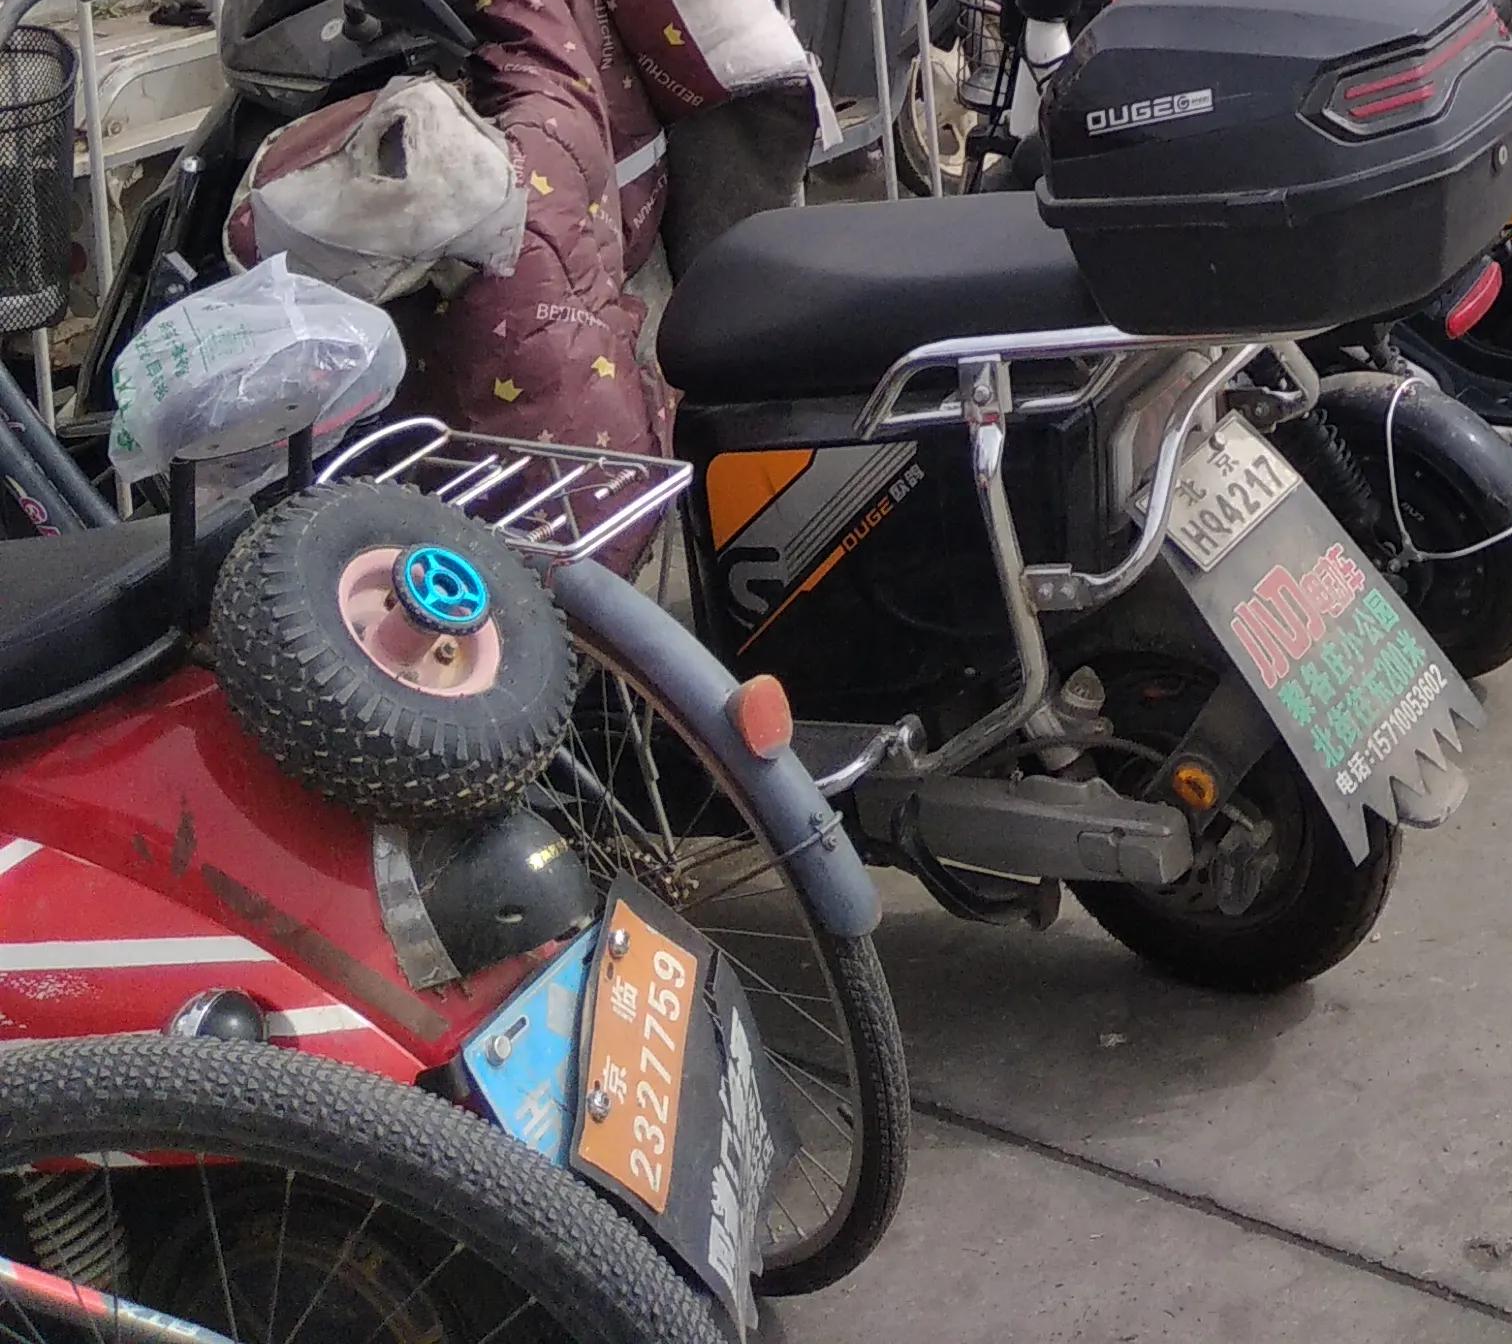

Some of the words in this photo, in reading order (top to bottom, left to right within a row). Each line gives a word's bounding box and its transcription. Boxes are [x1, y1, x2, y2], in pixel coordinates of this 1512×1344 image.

[1086, 95, 1175, 131] OUGE
[1175, 442, 1240, 507] 北京
[1180, 454, 1284, 556] HQ4217
[841, 495, 896, 553] OUGE
[1230, 542, 1367, 689] 小刀电动车
[629, 949, 686, 1194] 2327759
